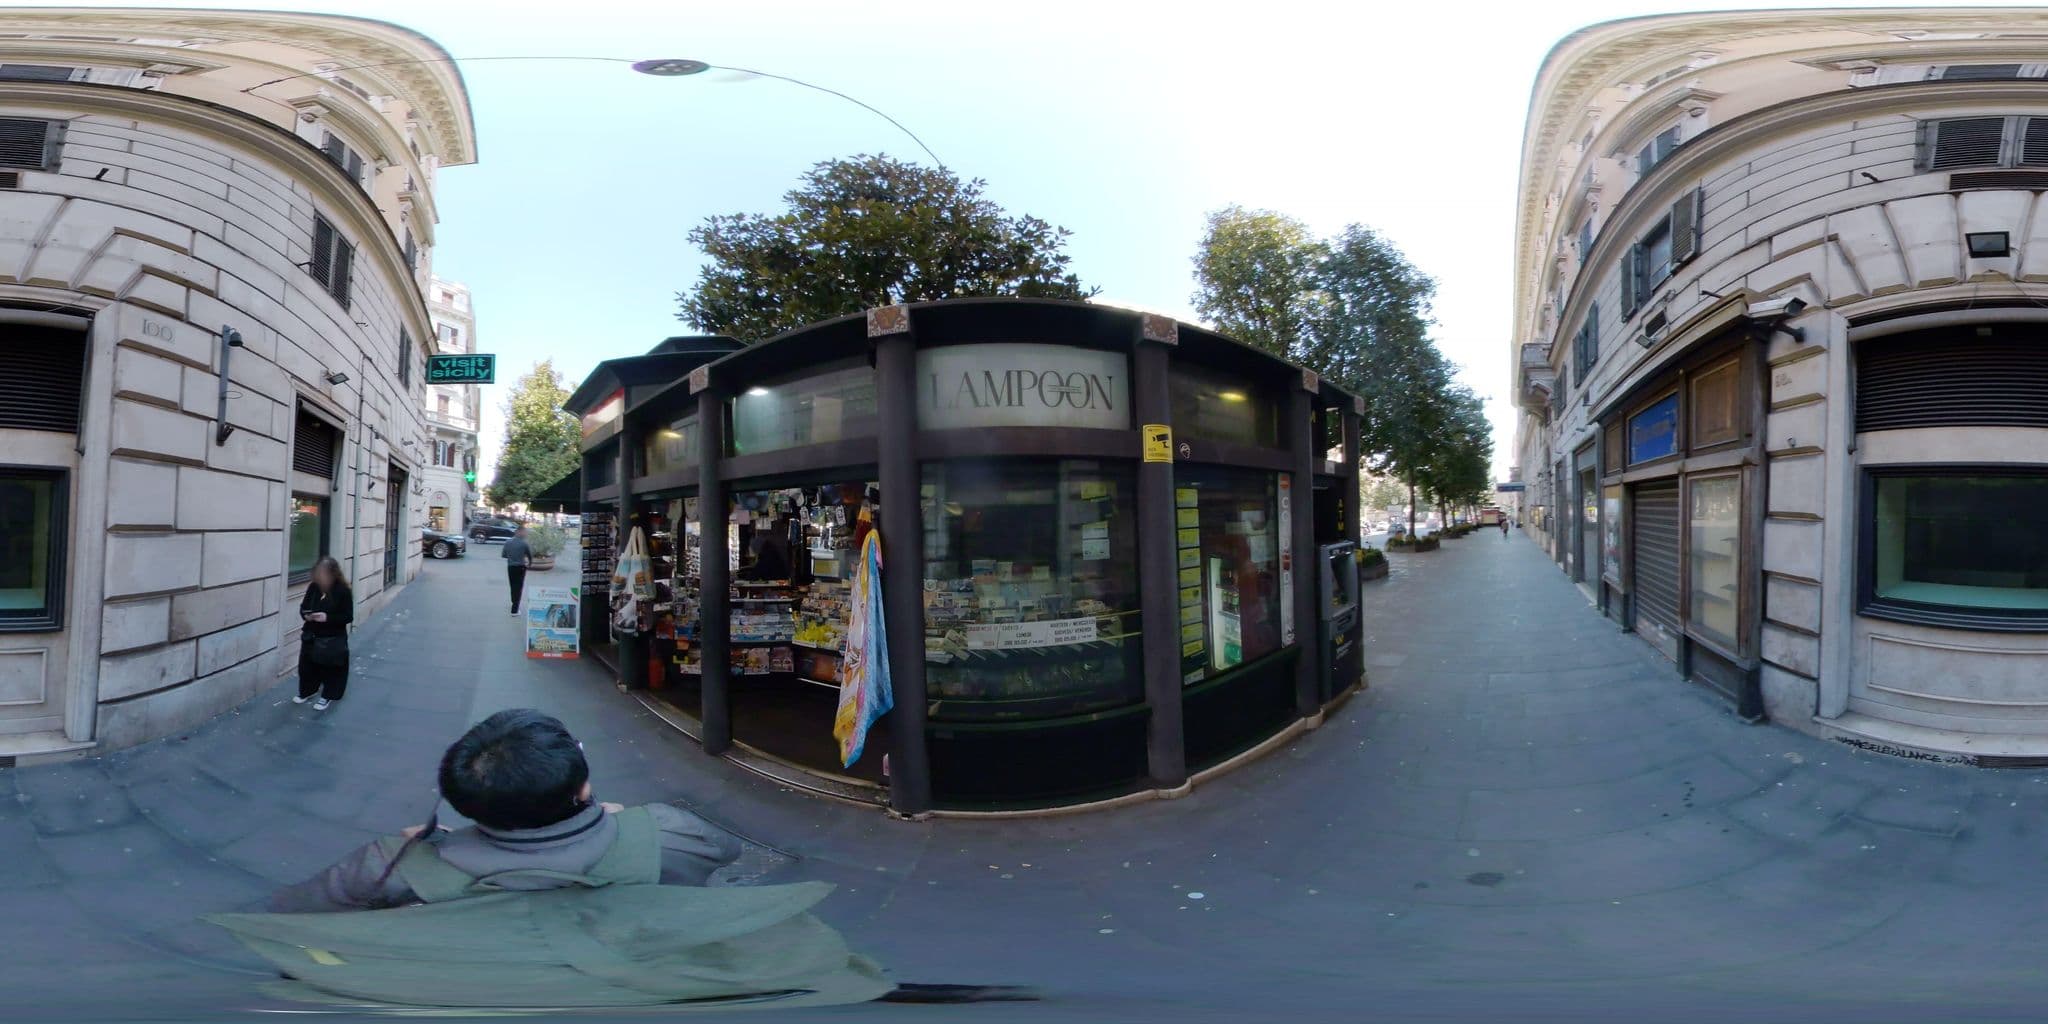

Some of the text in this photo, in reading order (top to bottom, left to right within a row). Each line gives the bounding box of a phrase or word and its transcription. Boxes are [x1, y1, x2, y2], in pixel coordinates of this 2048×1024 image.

[438, 357, 486, 367] visit
[432, 367, 489, 379] sicily
[930, 370, 1115, 411] LAMPOON
